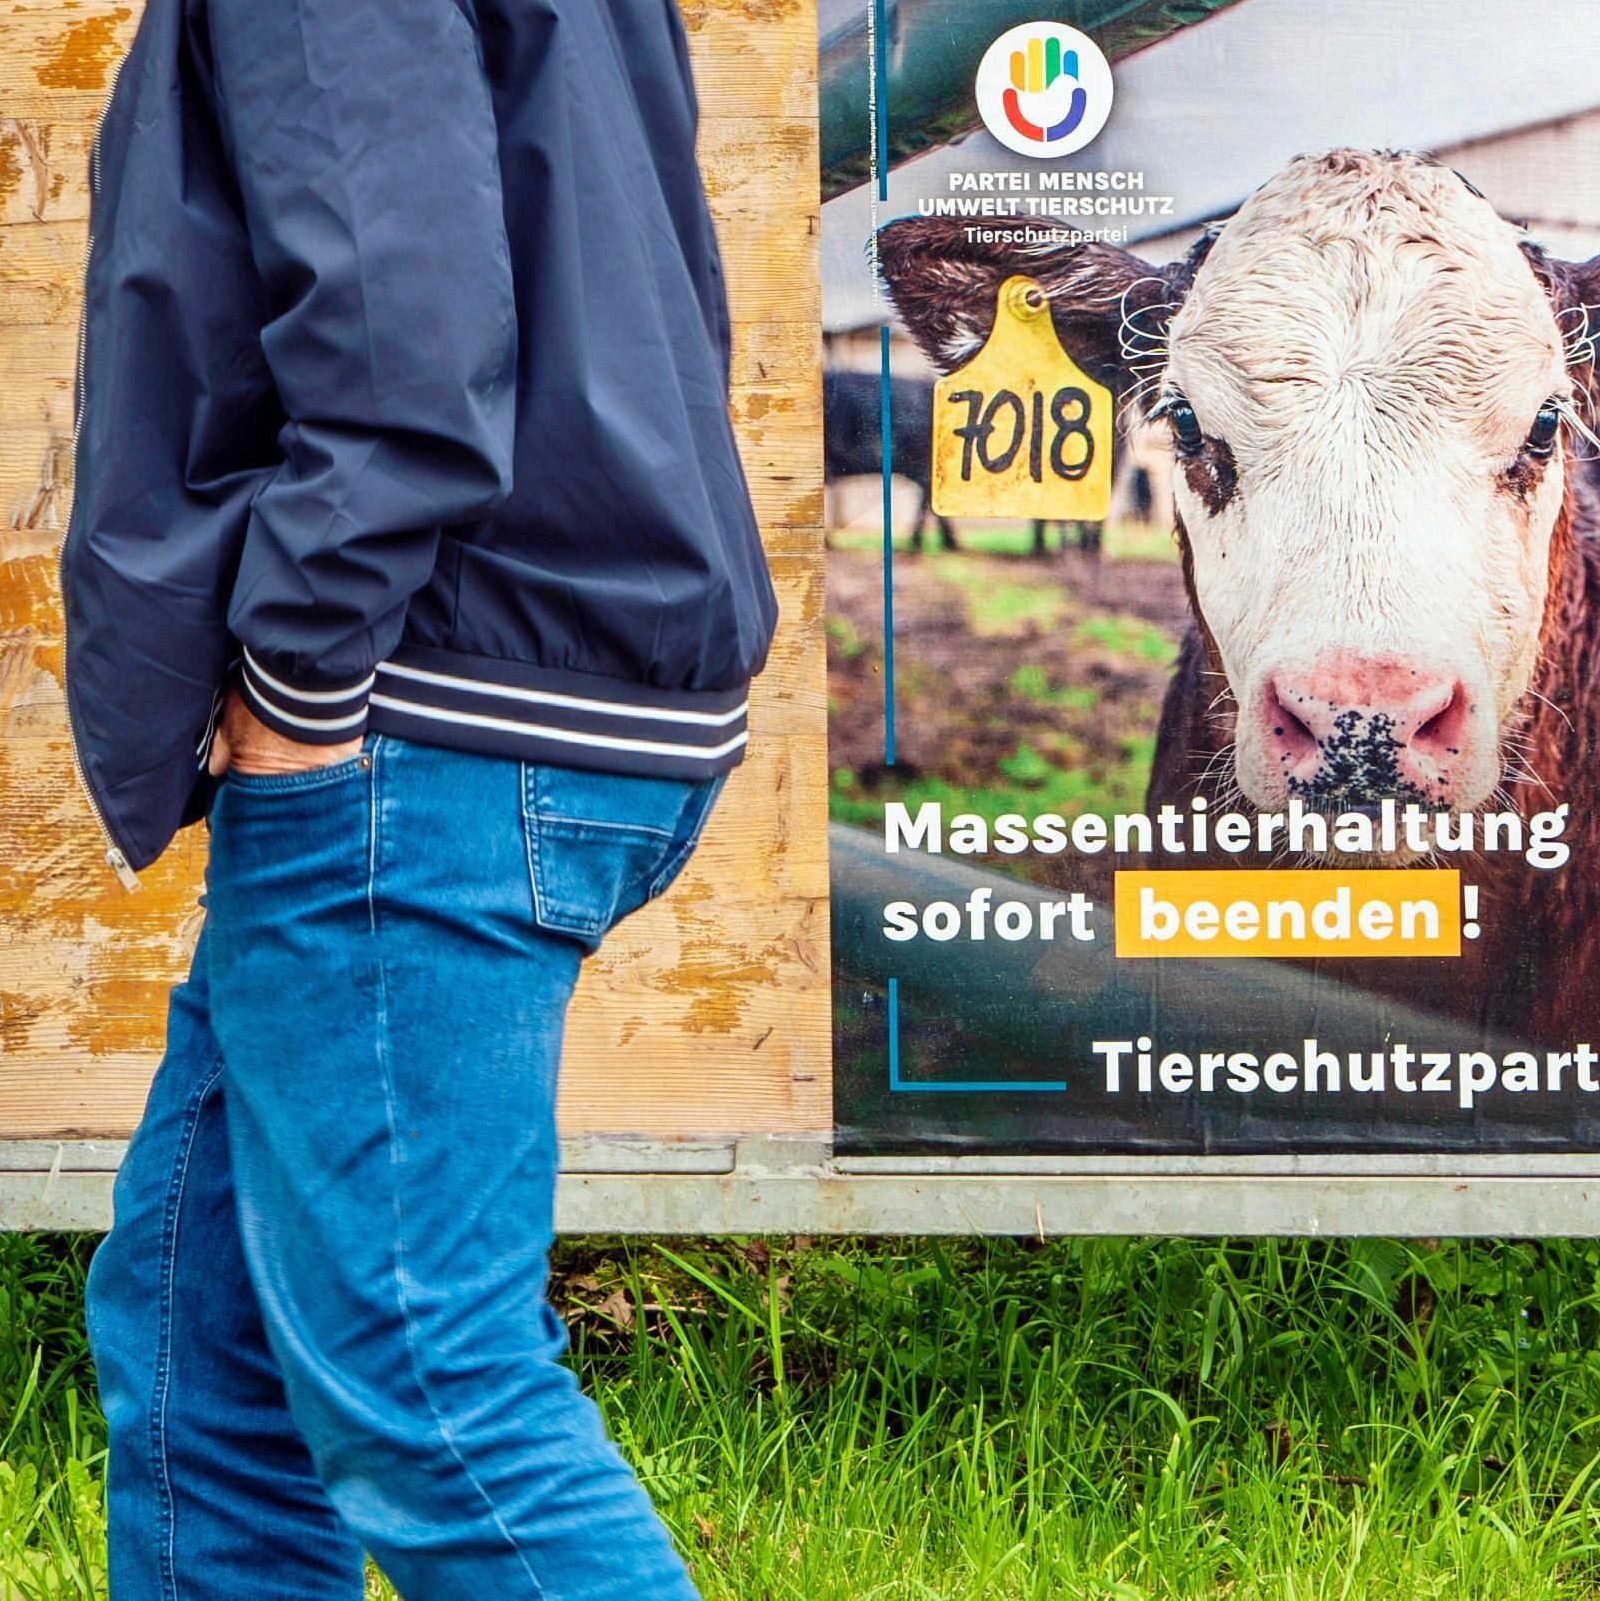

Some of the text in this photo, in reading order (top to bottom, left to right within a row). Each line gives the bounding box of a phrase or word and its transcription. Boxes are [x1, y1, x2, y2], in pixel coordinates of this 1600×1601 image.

[949, 171, 1144, 193] PARTEI MENSCH
[918, 195, 1175, 218] UMWELT TIERSCHUTZ
[964, 225, 1127, 247] Tierschutzpartei
[946, 386, 1095, 484] 7018
[884, 796, 1569, 870] Massentierhaltung
[883, 887, 1095, 941] sofort
